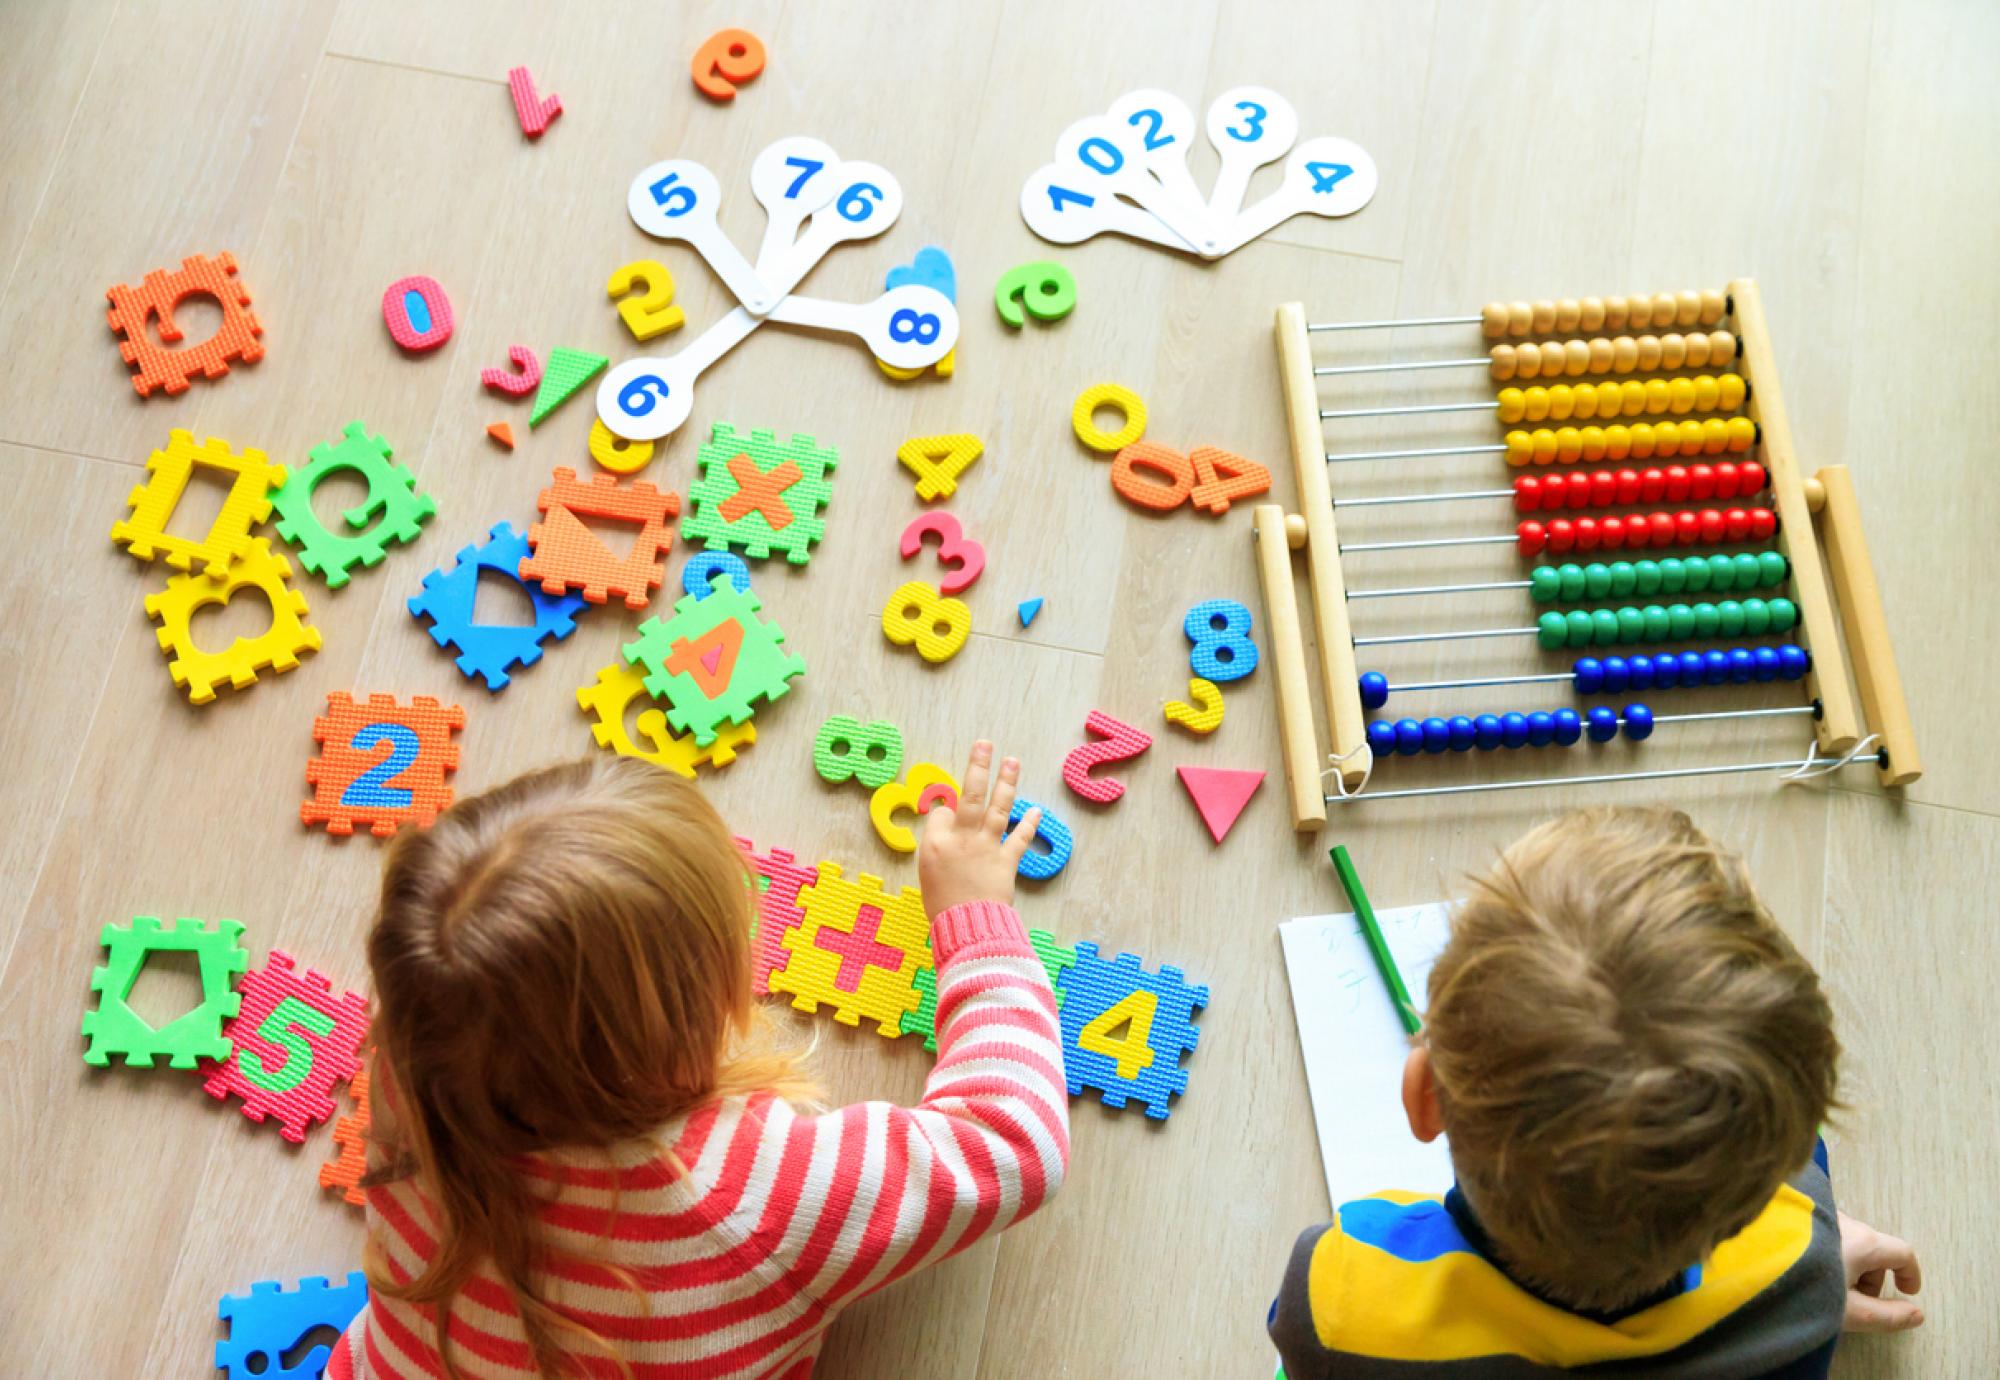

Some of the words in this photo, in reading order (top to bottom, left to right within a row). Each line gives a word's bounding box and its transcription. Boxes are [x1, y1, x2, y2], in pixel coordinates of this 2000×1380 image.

[1078, 137, 1124, 175] 0
[1128, 108, 1175, 152] 2
[1226, 101, 1267, 142] 3
[649, 173, 698, 218] 5
[784, 156, 824, 199] 7
[836, 182, 883, 222] 6
[1047, 184, 1095, 212] 1
[1304, 161, 1354, 194] 4
[382, 275, 455, 353] 0
[889, 308, 941, 345] 8
[897, 433, 985, 502] 4
[1190, 446, 1272, 516] 4
[900, 511, 986, 595] 3
[882, 581, 972, 663] 8
[1184, 599, 1259, 682] 8
[663, 617, 745, 700] 4
[340, 722, 420, 807] 2
[814, 714, 902, 789] 8
[238, 996, 336, 1092] 5
[1078, 990, 1158, 1079] 4
